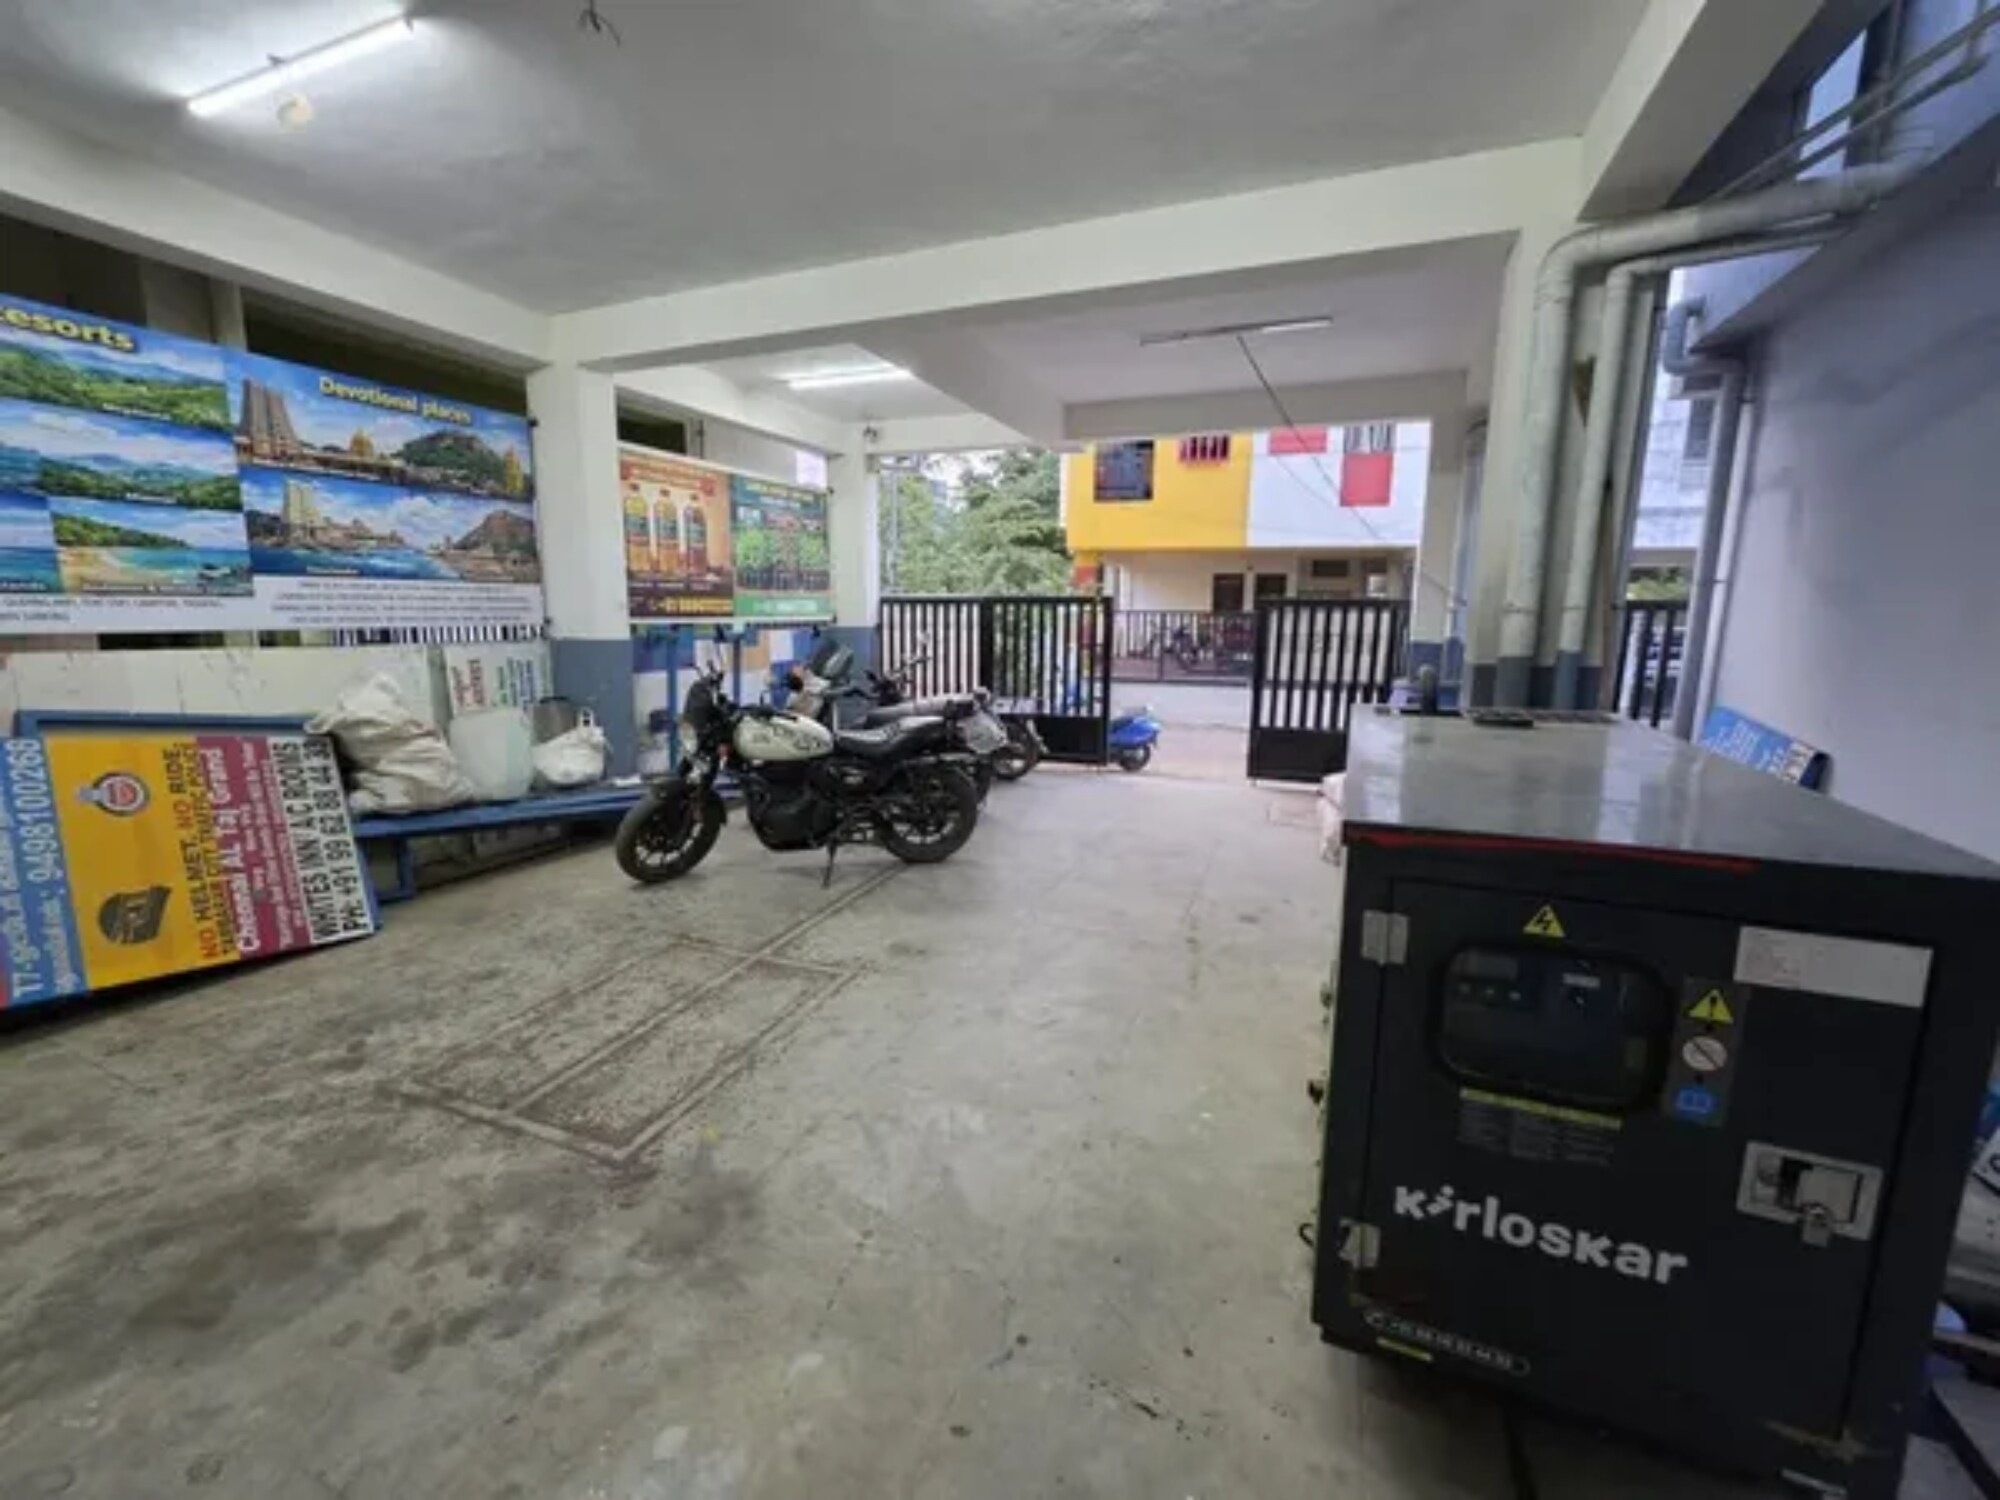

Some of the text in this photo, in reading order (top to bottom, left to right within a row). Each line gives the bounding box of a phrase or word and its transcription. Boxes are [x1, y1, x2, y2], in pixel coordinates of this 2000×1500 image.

[0, 307, 134, 352] esorts
[319, 375, 418, 411] Devotional
[273, 742, 307, 799] ROOMS
[306, 766, 330, 784] 44
[174, 800, 193, 830] NO
[201, 747, 259, 950] Chennai AL Taj Grand
[295, 839, 324, 870] INN
[323, 839, 352, 861] 99
[330, 866, 357, 894] +91
[302, 872, 340, 937] WHITES
[339, 900, 367, 932] PH:
[200, 926, 218, 958] NO
[1394, 1184, 1688, 1284] kirloskar
